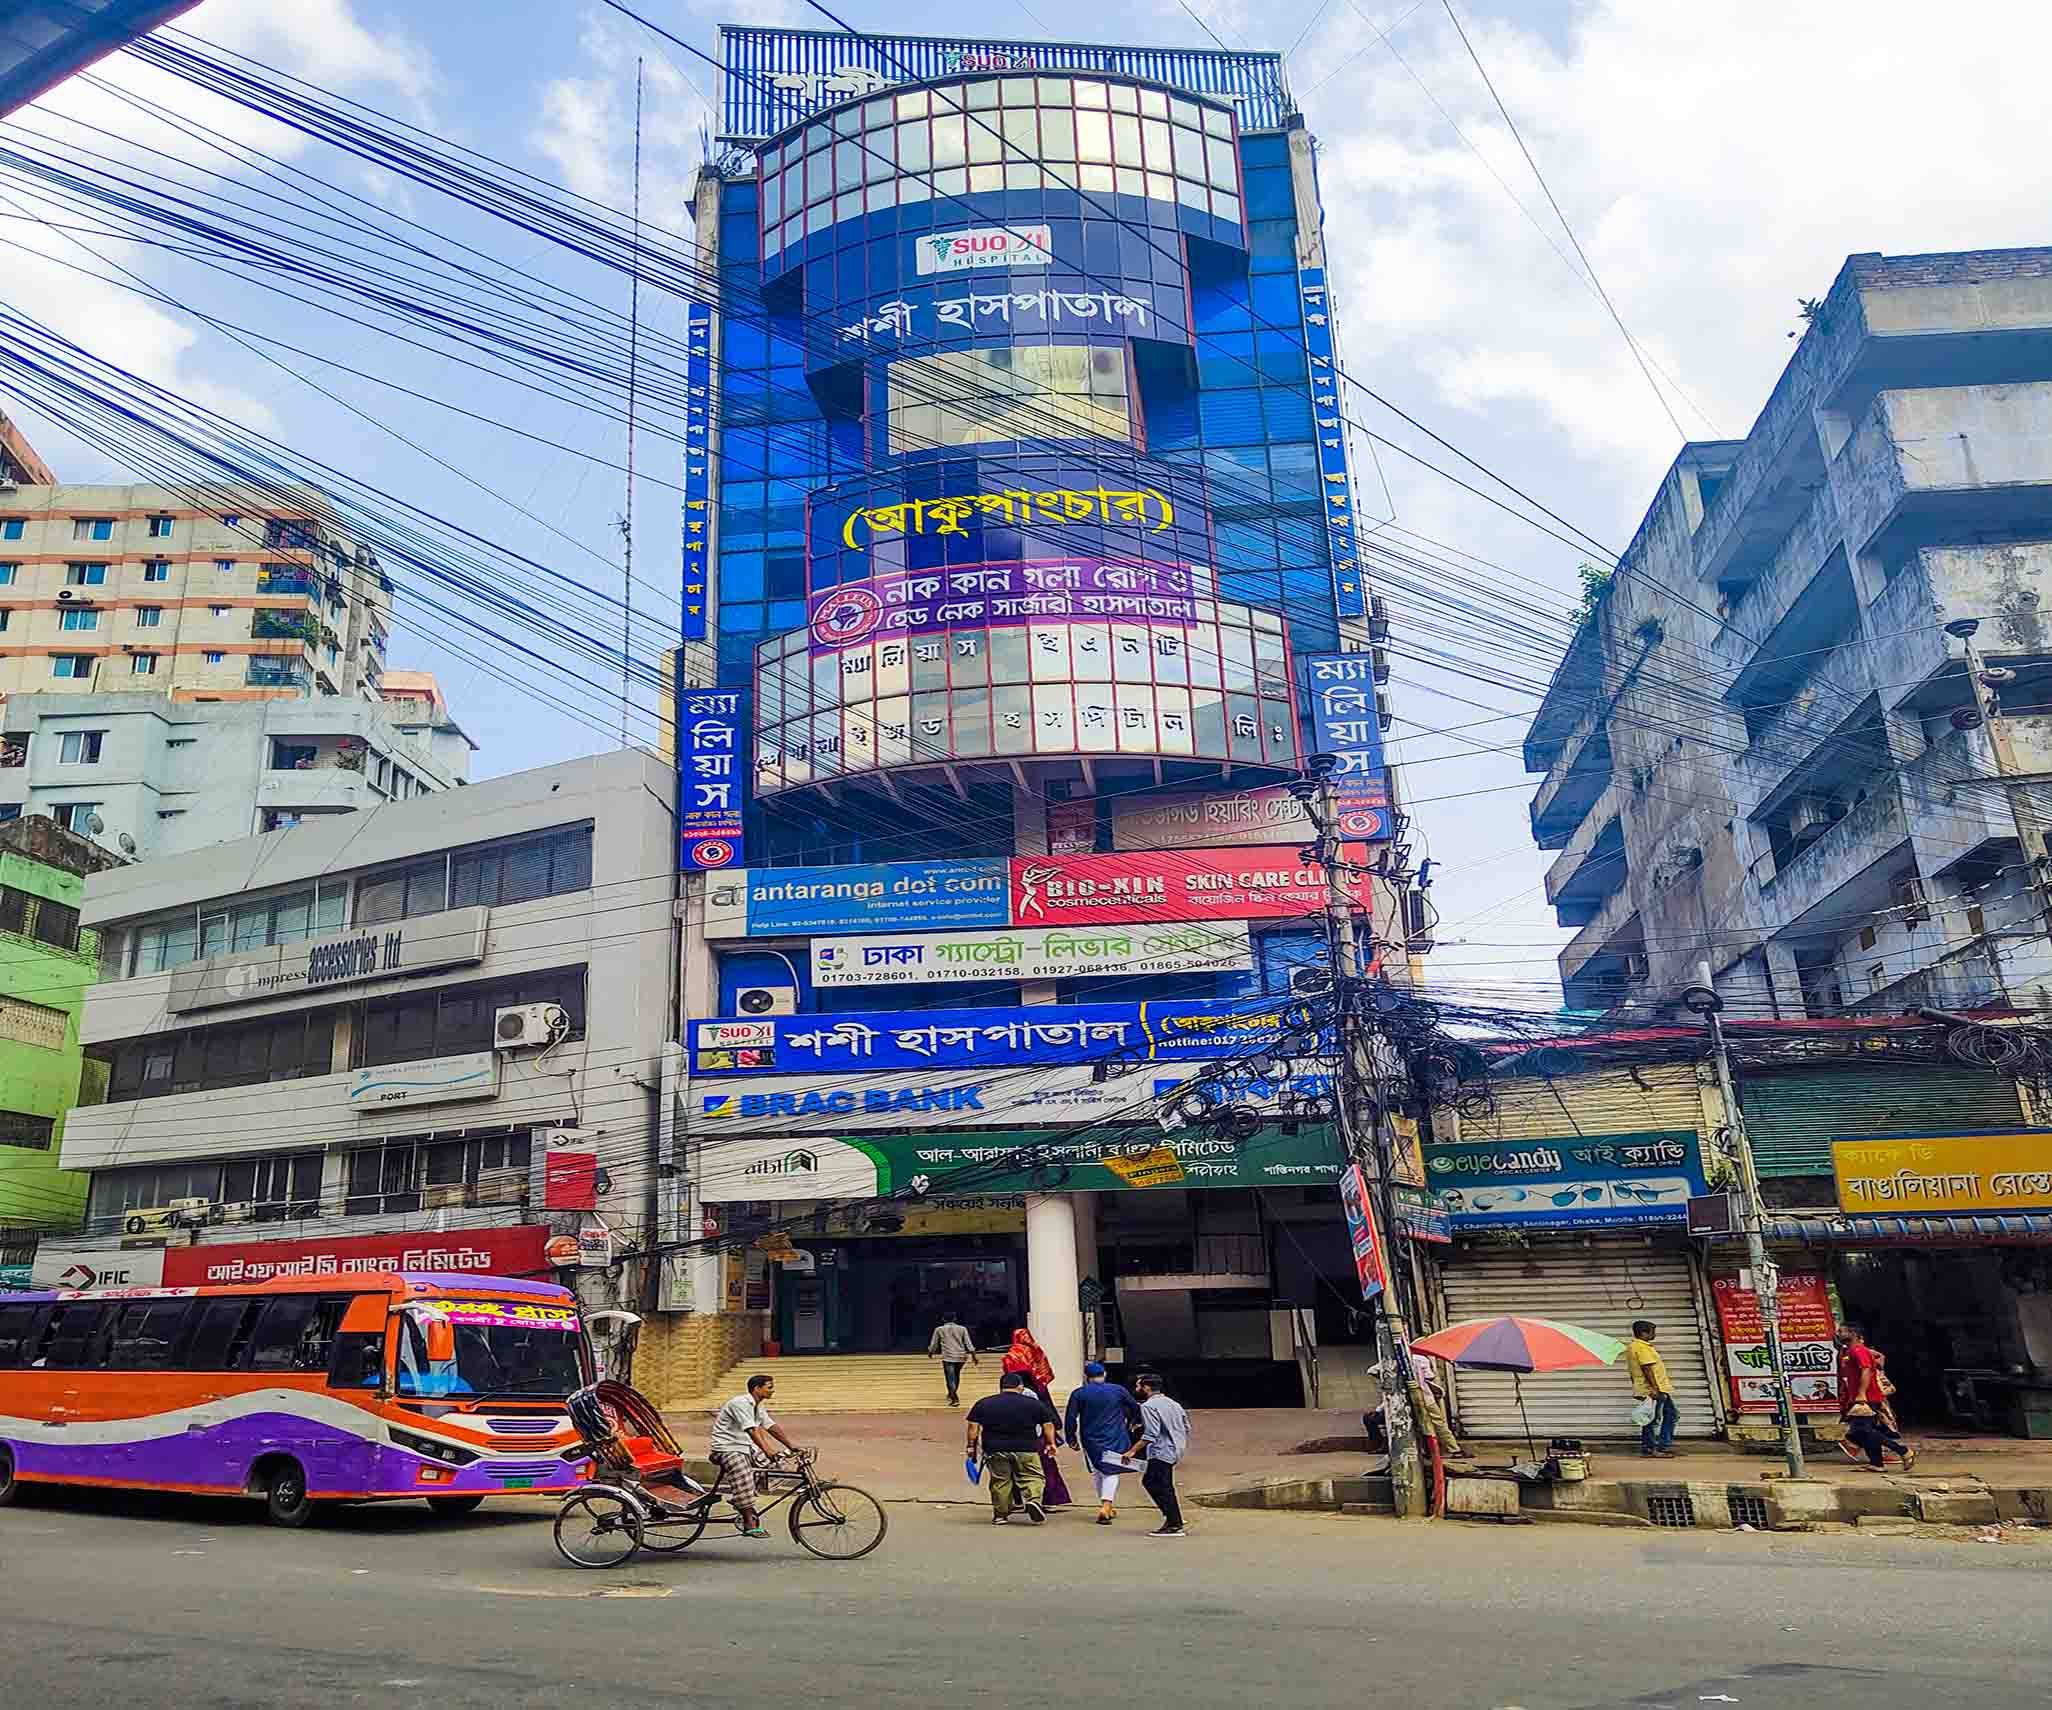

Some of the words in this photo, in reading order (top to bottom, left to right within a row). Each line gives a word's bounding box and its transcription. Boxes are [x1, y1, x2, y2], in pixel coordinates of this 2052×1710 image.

[952, 234, 1007, 254] SUO
[953, 253, 1046, 267] HOSPITAL
[838, 299, 919, 346] শশী
[931, 287, 1153, 333] হাসপাতাল
[842, 485, 1176, 552] (আকুপাংচার)
[884, 575, 943, 605] নাক
[950, 568, 1012, 597] কান
[1024, 564, 1081, 590] গলা
[1093, 563, 1157, 590] রোগ
[1167, 570, 1189, 593] ও
[886, 603, 930, 632] হেড
[936, 602, 984, 623] নেক
[992, 588, 1074, 617] সার্জারী
[1082, 594, 1192, 619] হাসপাতাল
[752, 879, 885, 902] antaranga
[893, 876, 937, 895] dot
[944, 875, 1001, 893] com
[1047, 875, 1165, 897] BIO-XIN
[1186, 874, 1233, 891] SKIN
[1238, 870, 1291, 889] CARE
[306, 929, 378, 985] accessories
[863, 944, 926, 966] ঢাকা
[719, 1027, 752, 1039] SUO
[784, 1022, 881, 1057] শশী
[889, 1019, 1132, 1057] হাসপাতাল
[740, 1091, 855, 1117] BRAC
[864, 1085, 986, 1113] BANK
[1160, 1139, 1235, 1157] লিমিটেড
[1572, 1143, 1618, 1165] আই
[1622, 1138, 1687, 1164] ক্যান্ডি
[342, 1257, 399, 1274] ব্যাংক
[402, 1247, 492, 1272] লিমিটেড
[98, 1270, 130, 1285] IFIC
